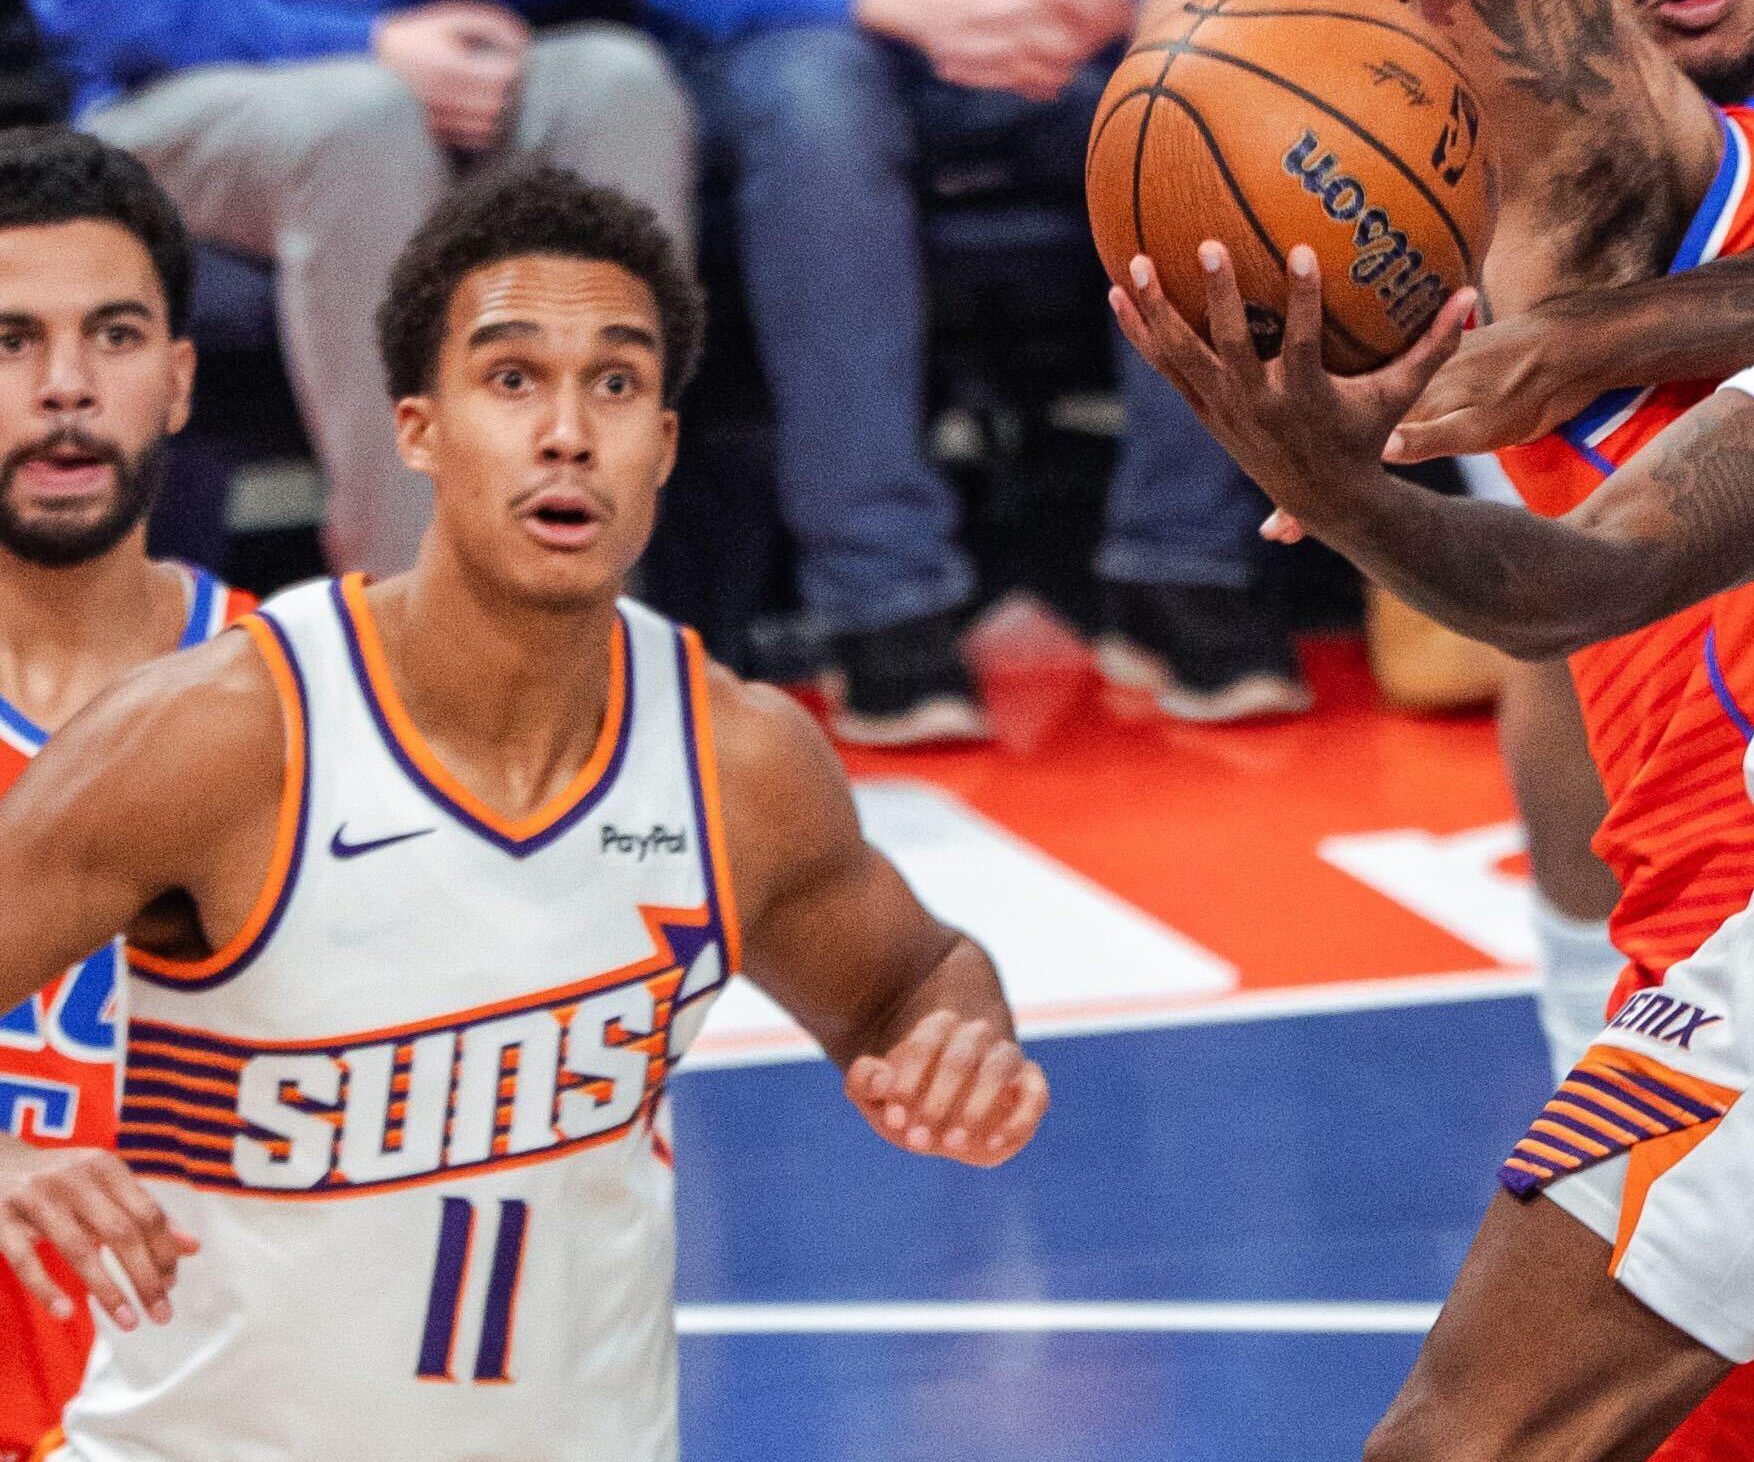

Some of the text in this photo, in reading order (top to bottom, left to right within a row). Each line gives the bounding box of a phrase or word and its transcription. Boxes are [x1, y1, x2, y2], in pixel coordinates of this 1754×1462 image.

[600, 825, 687, 863] PayPal
[1606, 991, 1725, 1050] ENIX
[232, 981, 655, 1190] SUNS
[416, 1196, 534, 1384] 11
